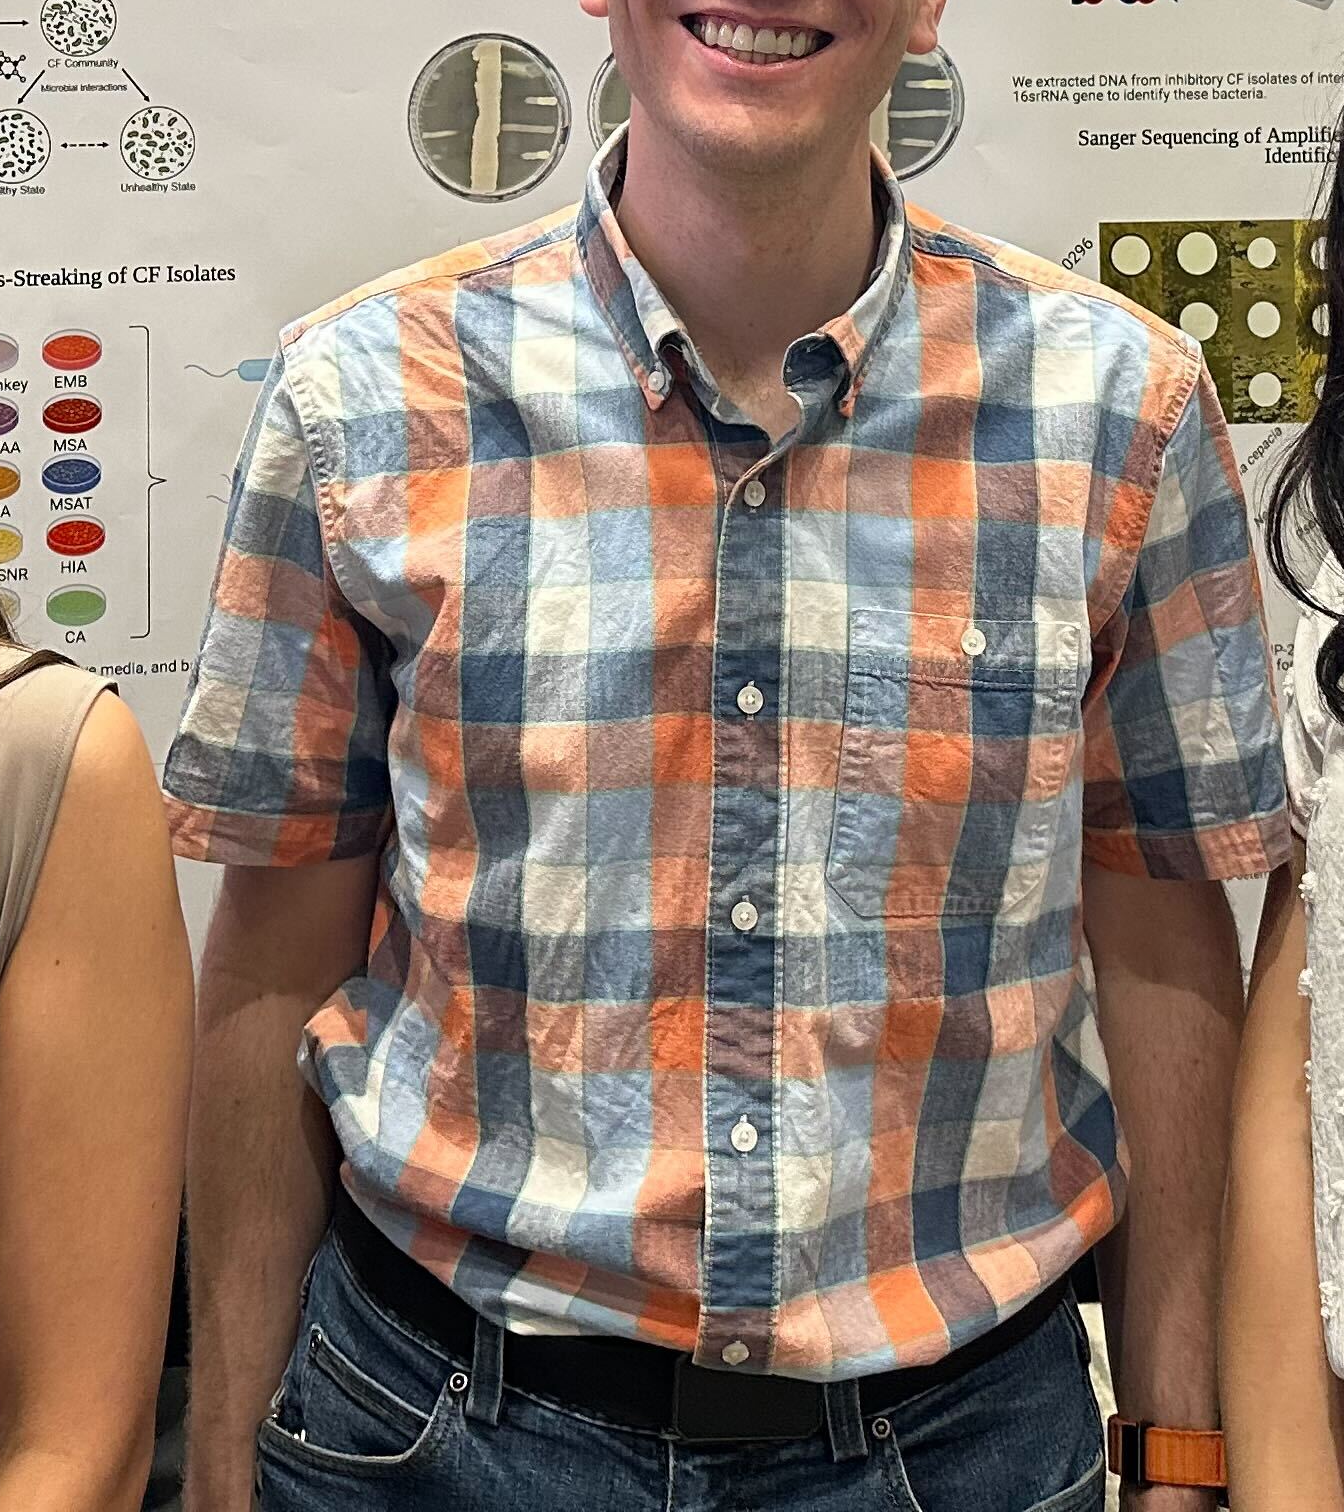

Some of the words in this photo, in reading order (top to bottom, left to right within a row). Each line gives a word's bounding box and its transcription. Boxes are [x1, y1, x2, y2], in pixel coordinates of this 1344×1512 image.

[107, 265, 128, 285] of
[132, 265, 161, 284] CF
[166, 263, 236, 283] Isolates
[54, 374, 88, 389] EMB
[53, 438, 88, 453] MSA
[50, 496, 94, 512] MSAT
[60, 559, 88, 574] HIA
